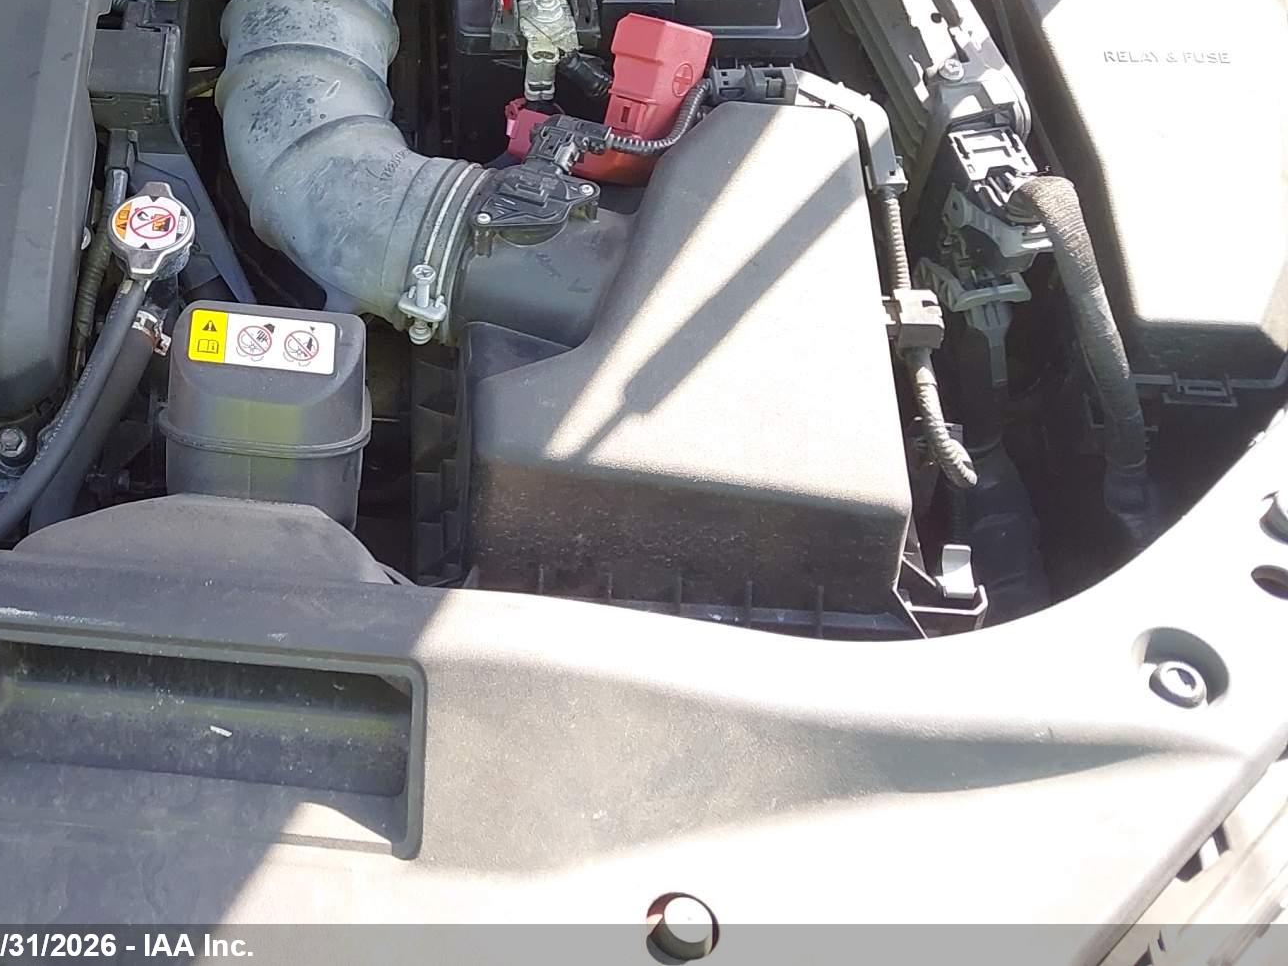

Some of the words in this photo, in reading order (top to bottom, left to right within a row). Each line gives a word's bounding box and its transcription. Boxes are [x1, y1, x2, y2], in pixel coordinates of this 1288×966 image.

[1102, 50, 1159, 64] RELAY
[1165, 51, 1178, 64] &
[1182, 51, 1232, 65] FUSE
